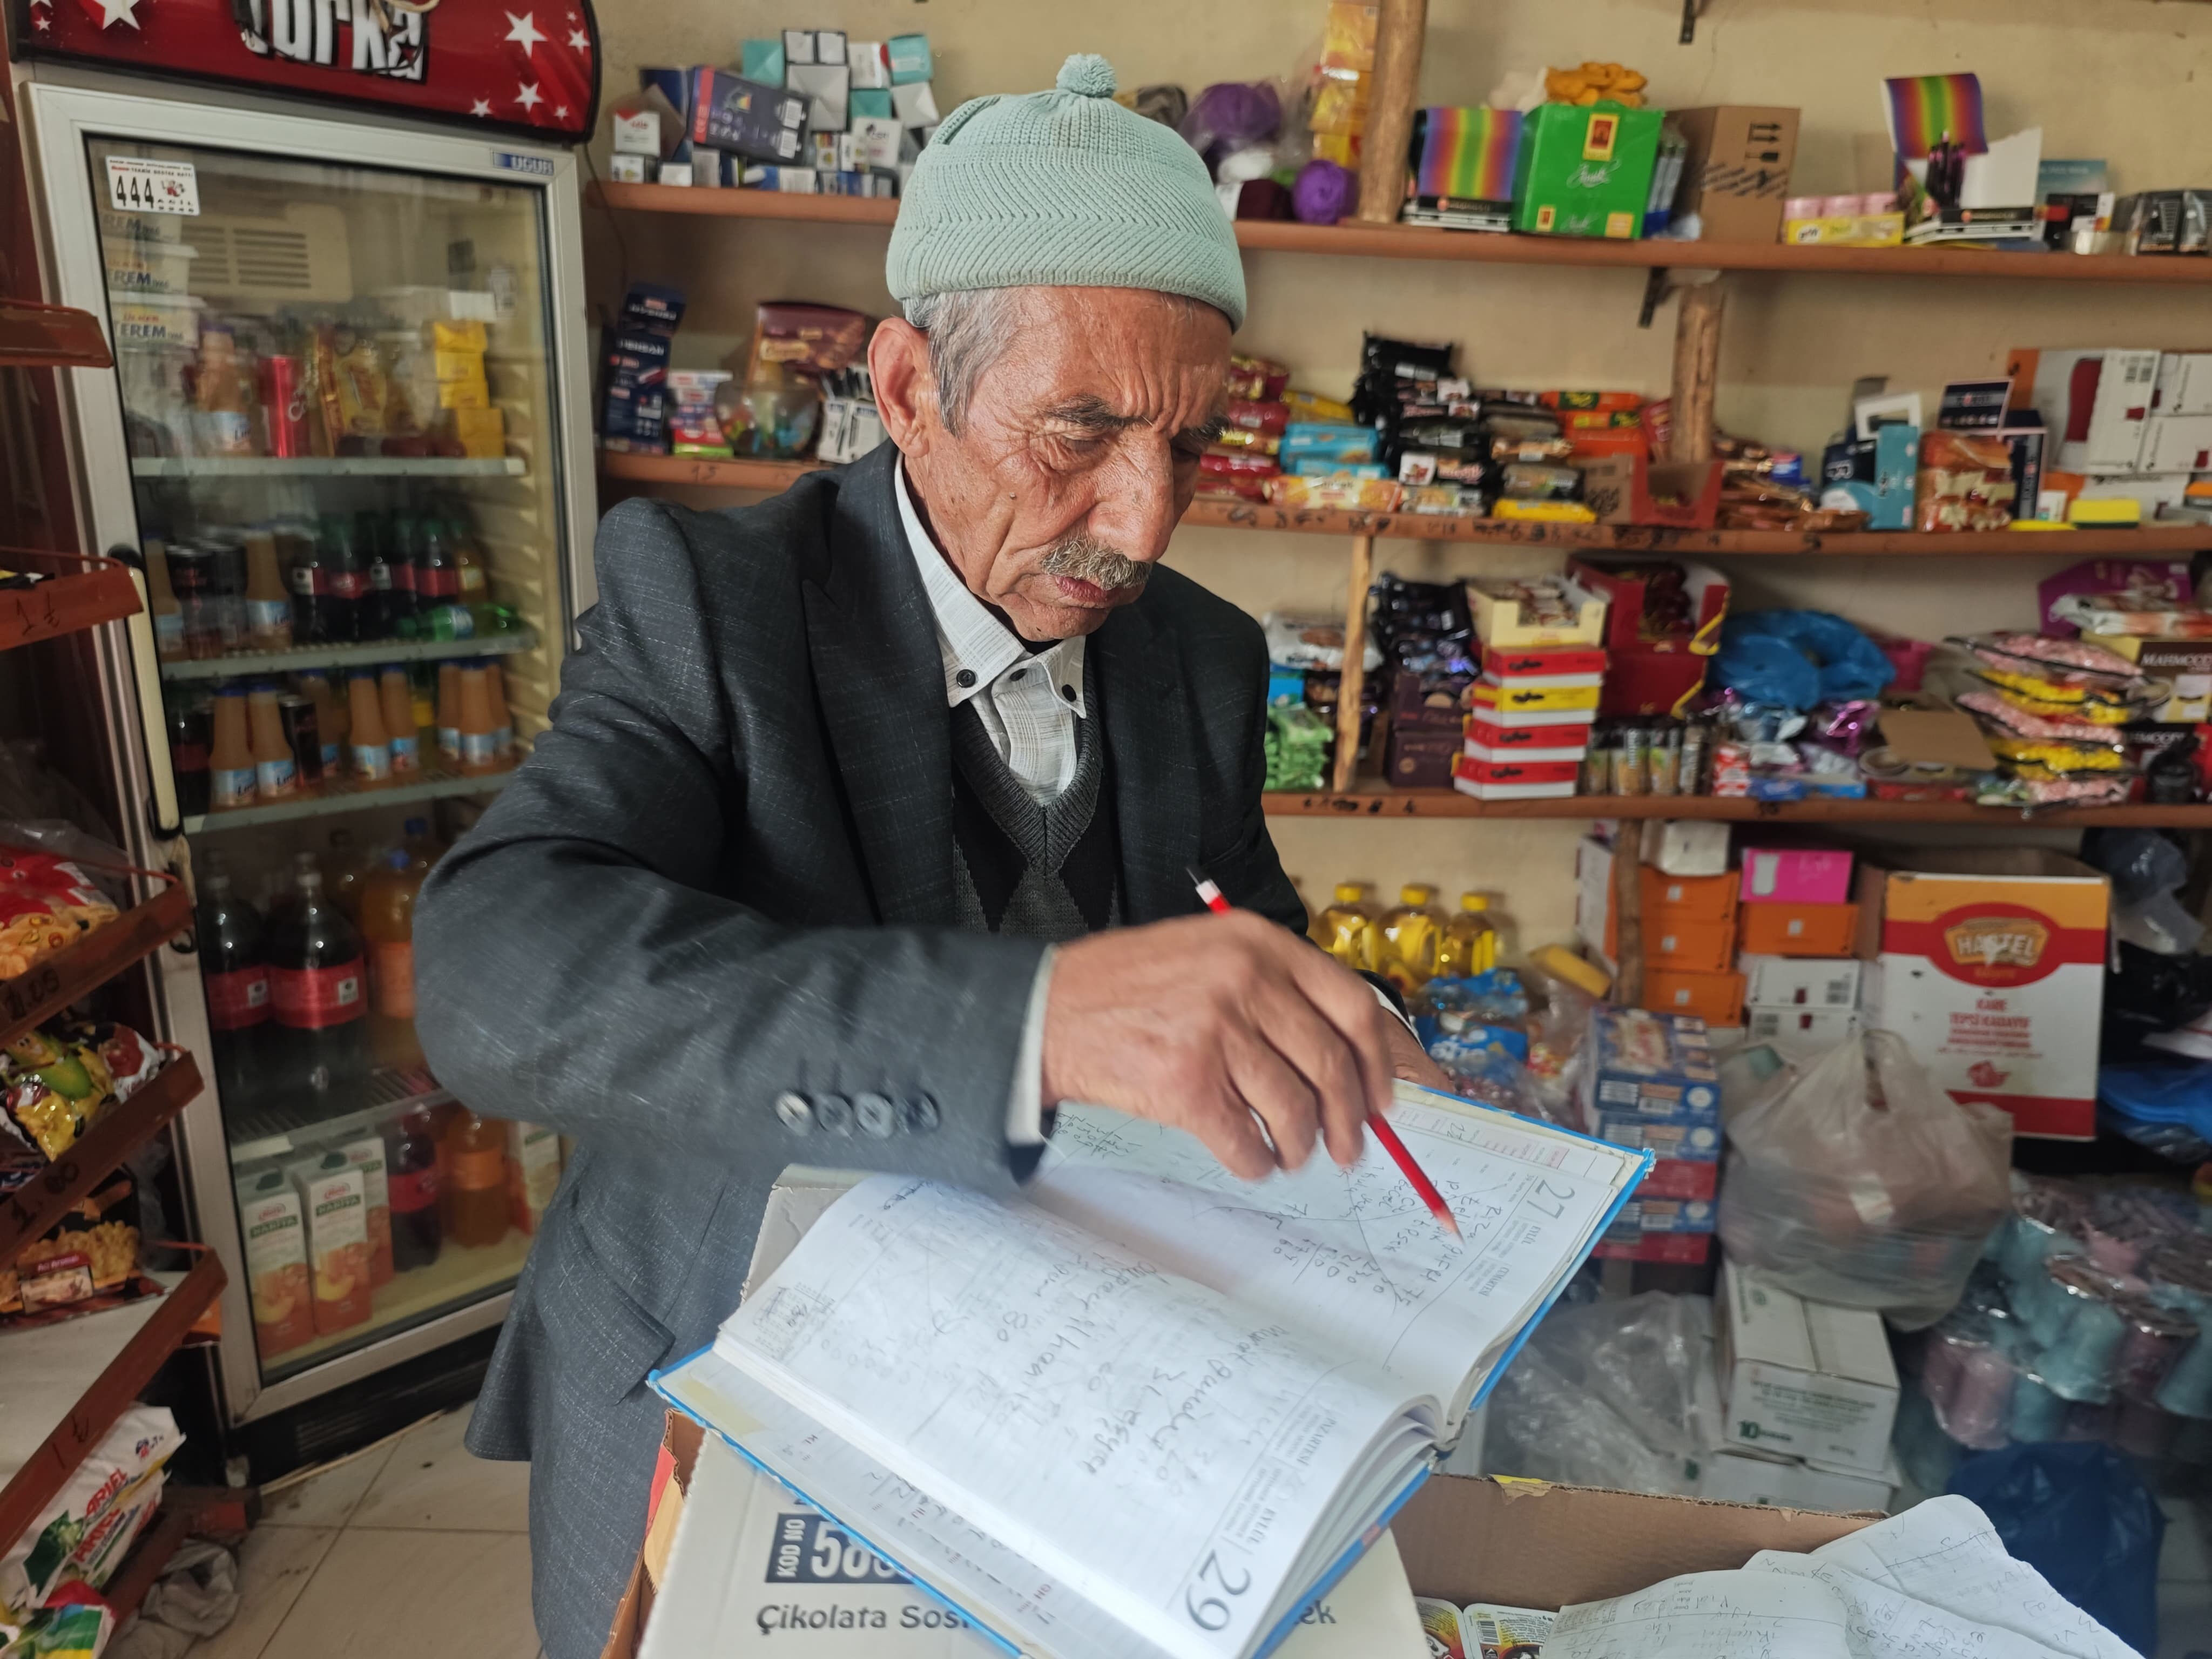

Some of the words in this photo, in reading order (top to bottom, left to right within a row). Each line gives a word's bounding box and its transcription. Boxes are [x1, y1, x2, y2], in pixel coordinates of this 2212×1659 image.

[116, 175, 154, 208] 444
[1527, 1178, 1576, 1219] 27
[775, 1543, 802, 1579] KOD
[1186, 1549, 1251, 1631] 29
[756, 1603, 887, 1636] Çikolata
